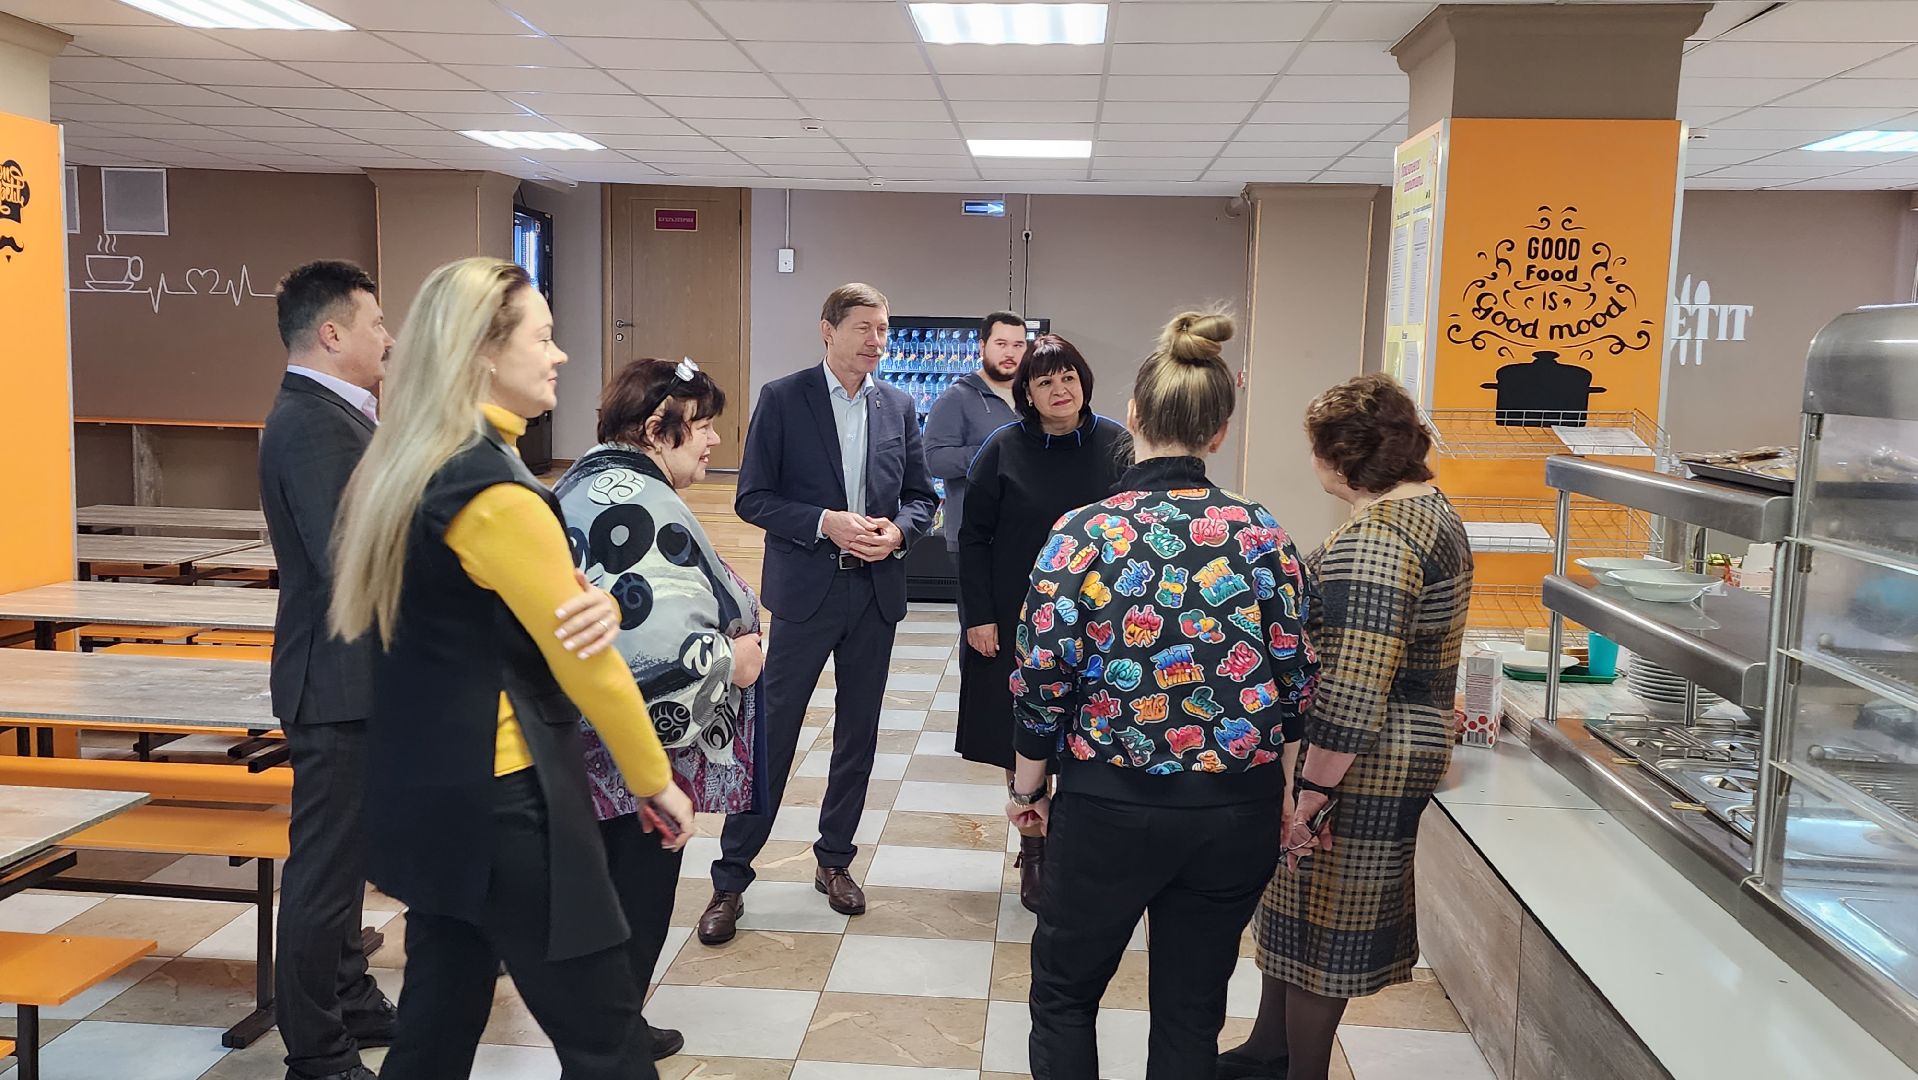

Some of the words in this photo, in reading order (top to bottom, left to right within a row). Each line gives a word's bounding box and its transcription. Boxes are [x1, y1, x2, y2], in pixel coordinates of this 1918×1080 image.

[1527, 236, 1581, 261] GOOD
[1525, 264, 1578, 282] Food
[1542, 290, 1559, 311] IS
[1471, 292, 1539, 339] Good
[1549, 296, 1628, 340] mood
